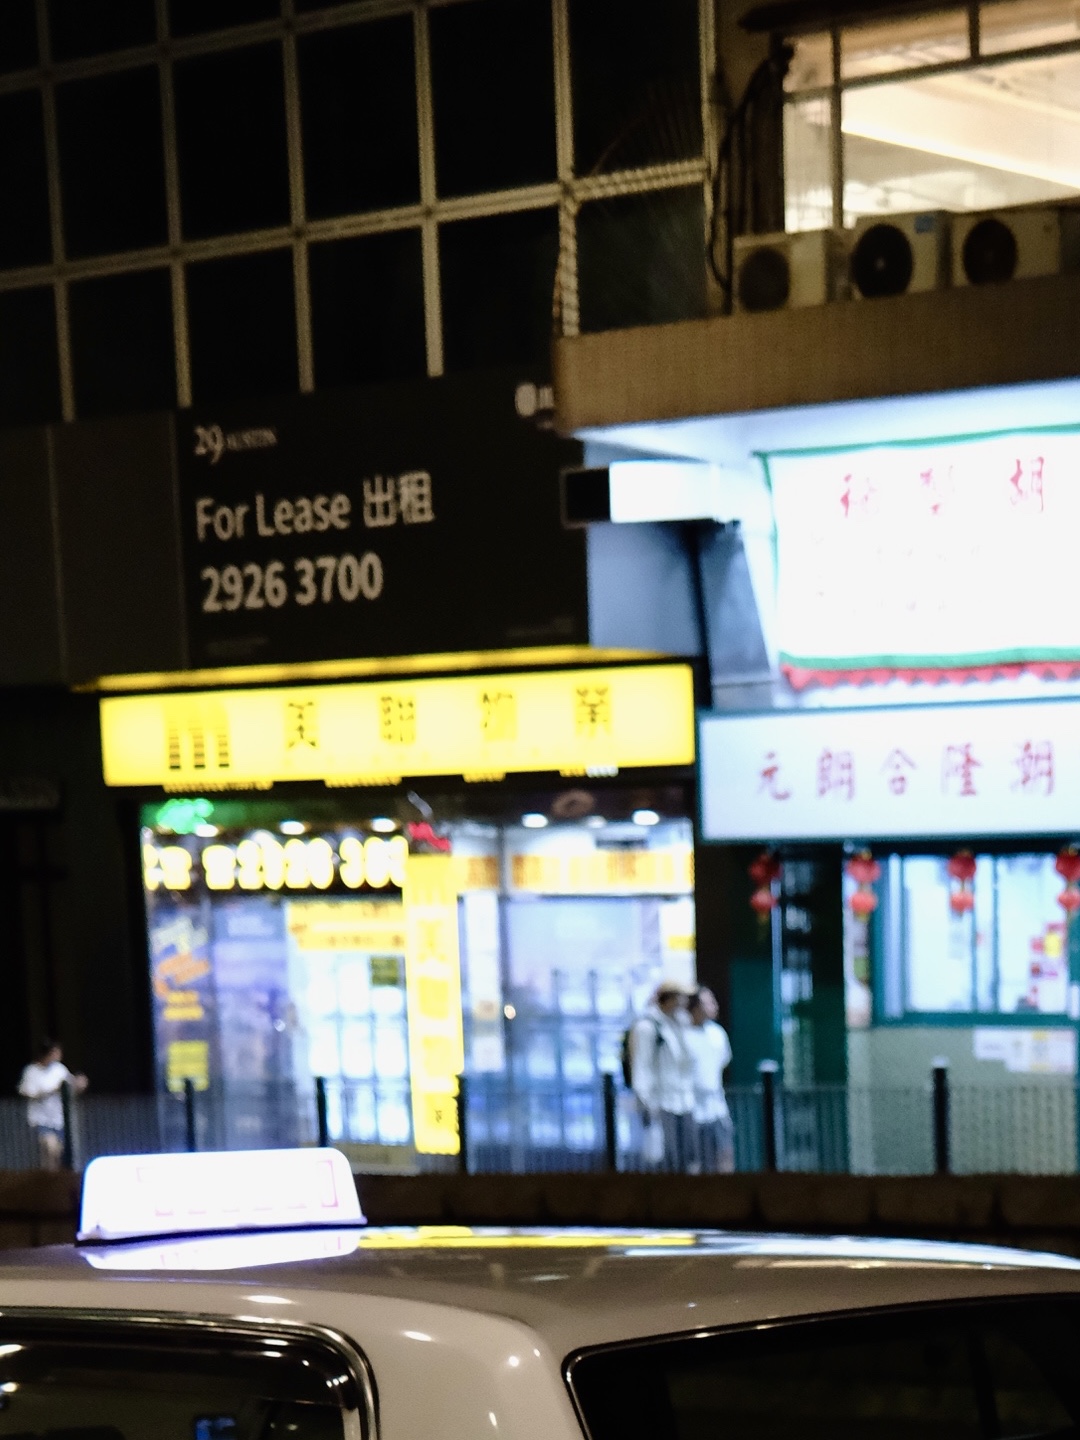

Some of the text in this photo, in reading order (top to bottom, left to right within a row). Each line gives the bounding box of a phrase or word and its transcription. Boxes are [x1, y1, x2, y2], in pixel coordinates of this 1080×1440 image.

[193, 424, 225, 465] 29
[196, 469, 435, 541] For Lease 出租
[202, 551, 384, 613] 2926 3700
